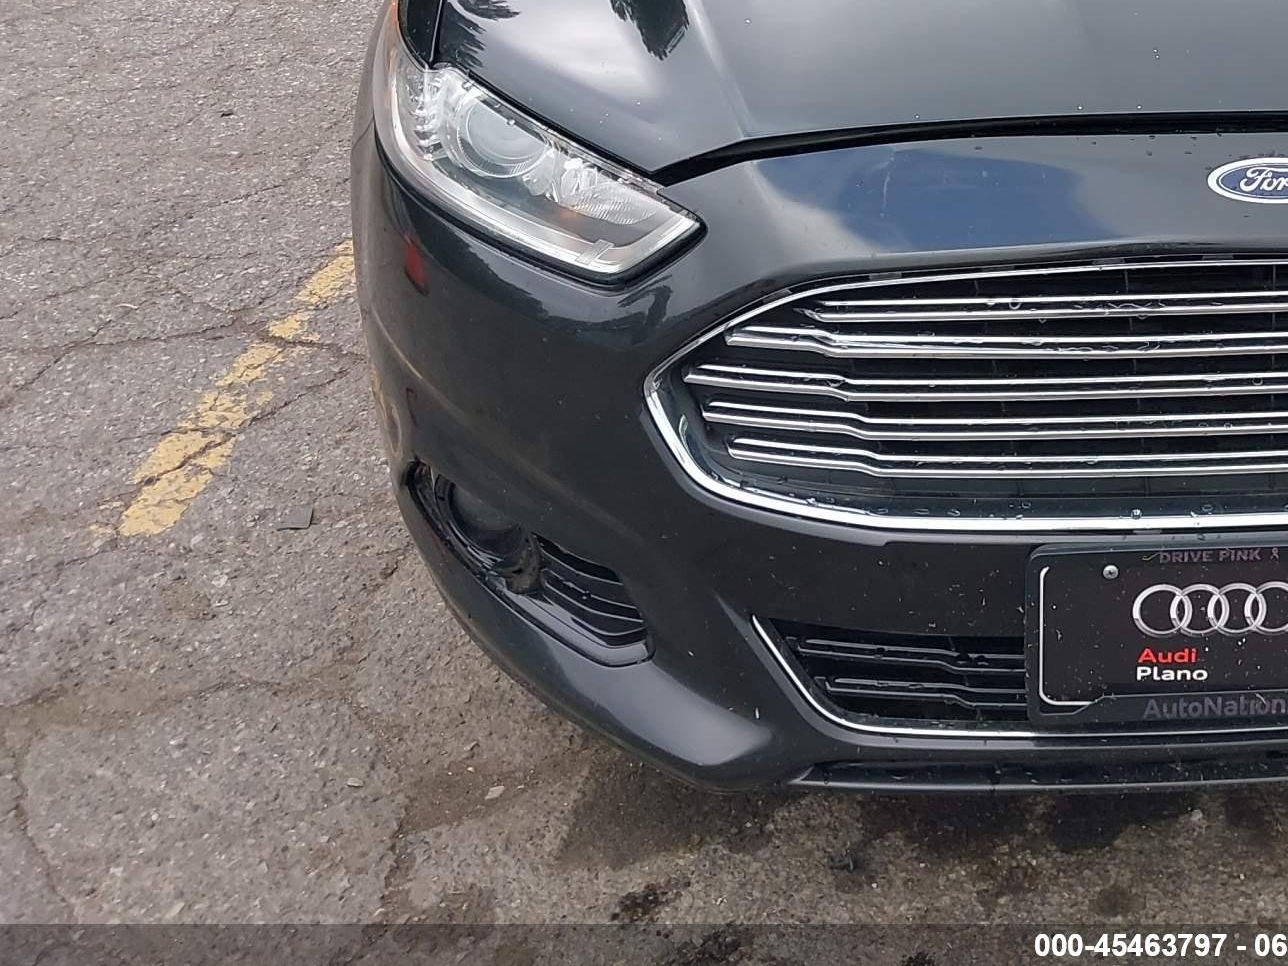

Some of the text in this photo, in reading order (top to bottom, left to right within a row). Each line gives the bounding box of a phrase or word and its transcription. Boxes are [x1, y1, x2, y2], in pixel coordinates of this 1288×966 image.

[1159, 547, 1262, 564] DRIVE PINK
[1137, 647, 1198, 664] Audi
[1136, 665, 1209, 681] Plano
[1142, 694, 1288, 720] AutoNation
